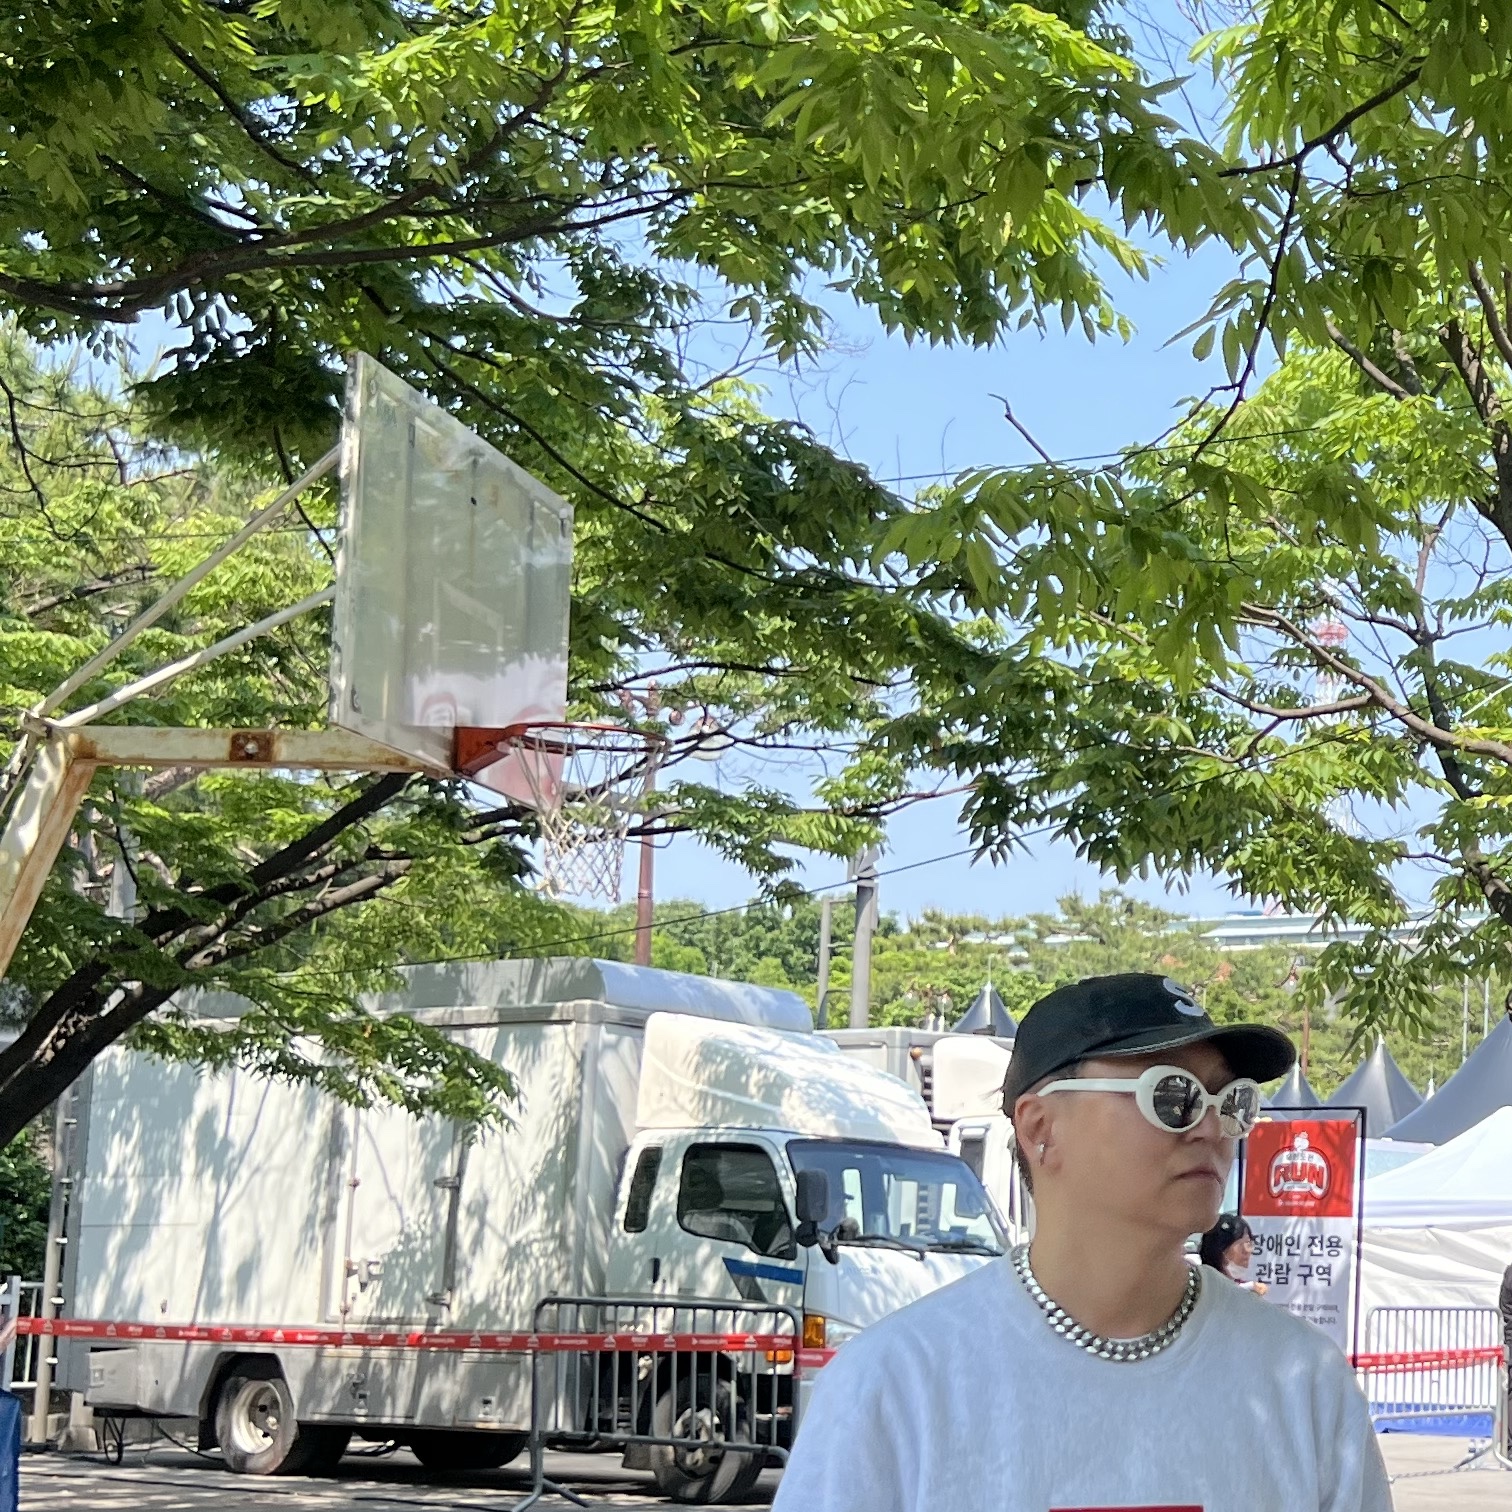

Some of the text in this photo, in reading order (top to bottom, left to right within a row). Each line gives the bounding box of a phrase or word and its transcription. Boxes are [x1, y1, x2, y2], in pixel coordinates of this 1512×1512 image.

[1273, 1161, 1325, 1190] RUN
[1252, 1233, 1344, 1258] 장애인 전용
[1255, 1262, 1332, 1287] 관람 구역
